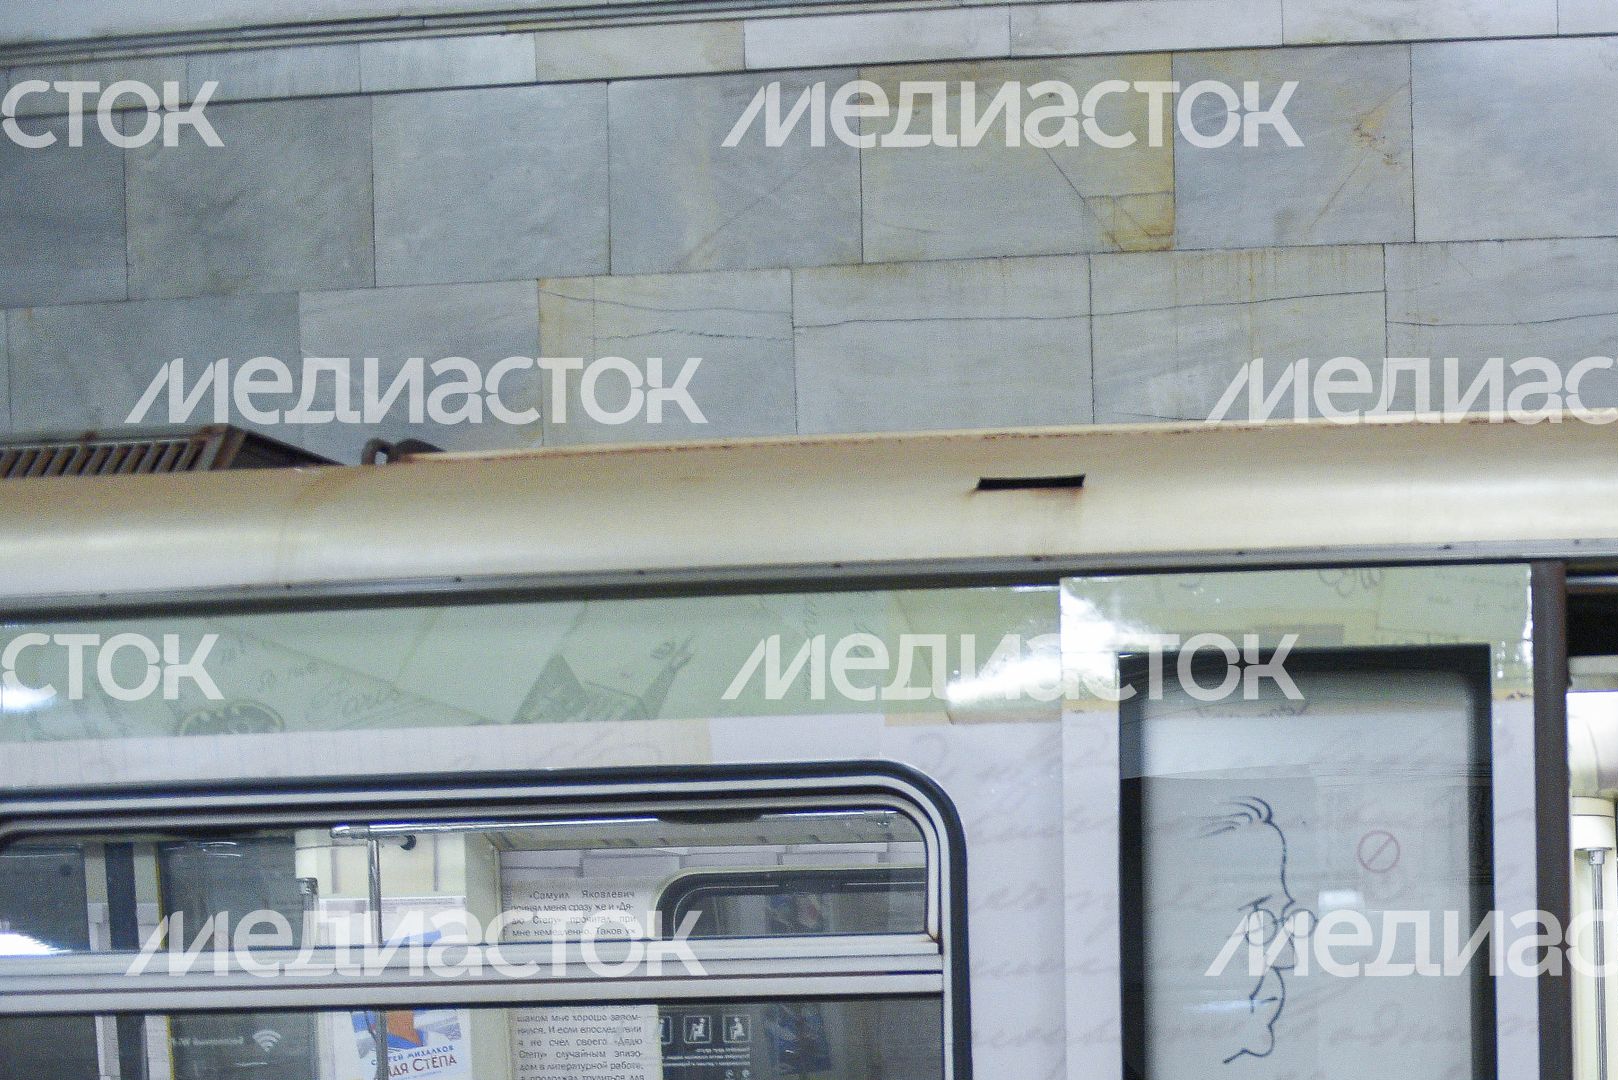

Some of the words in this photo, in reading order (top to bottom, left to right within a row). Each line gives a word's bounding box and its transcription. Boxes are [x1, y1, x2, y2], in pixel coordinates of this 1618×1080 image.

[582, 889, 636, 899] Яковлевич
[543, 903, 567, 912] меня
[568, 903, 592, 913] сразу
[512, 929, 531, 937] мне
[572, 1013, 608, 1023] хорошо
[557, 1026, 578, 1034] если
[530, 1039, 542, 1047] не
[576, 1038, 608, 1046] своего
[555, 1049, 606, 1060] случайным
[546, 1062, 608, 1074] литературной
